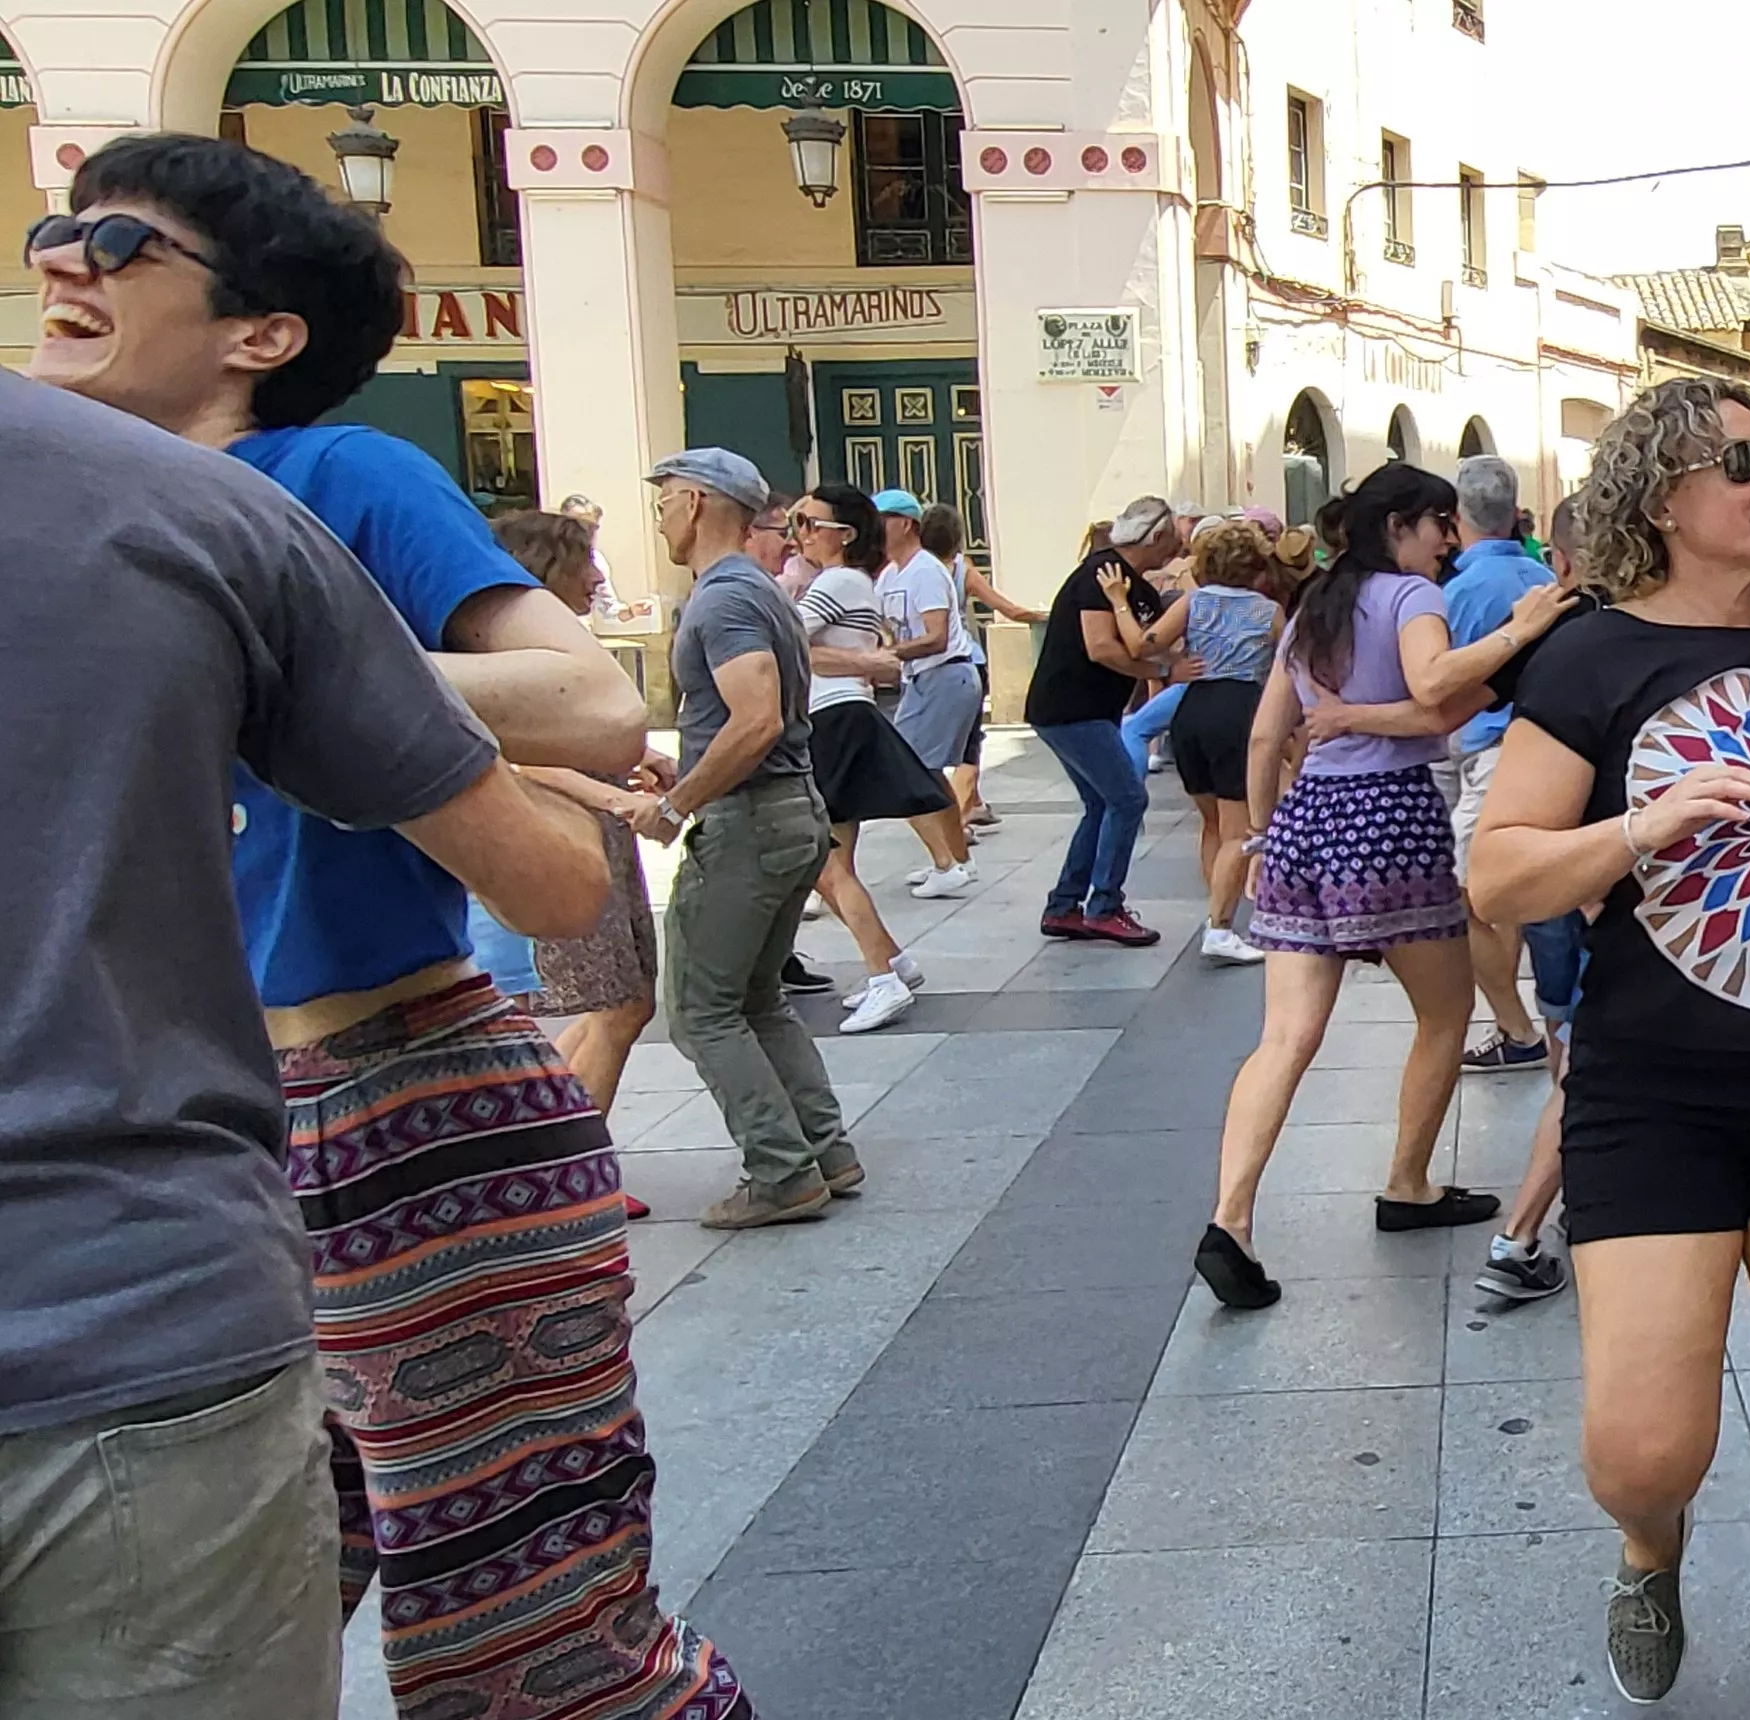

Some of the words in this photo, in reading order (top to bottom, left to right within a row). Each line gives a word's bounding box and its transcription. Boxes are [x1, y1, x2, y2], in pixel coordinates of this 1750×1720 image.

[380, 72, 404, 102] LA
[408, 72, 502, 102] CONFIANZA
[842, 79, 883, 102] 1871
[733, 289, 942, 336] ULTRAMARINOS
[1068, 322, 1103, 330] PLAZA
